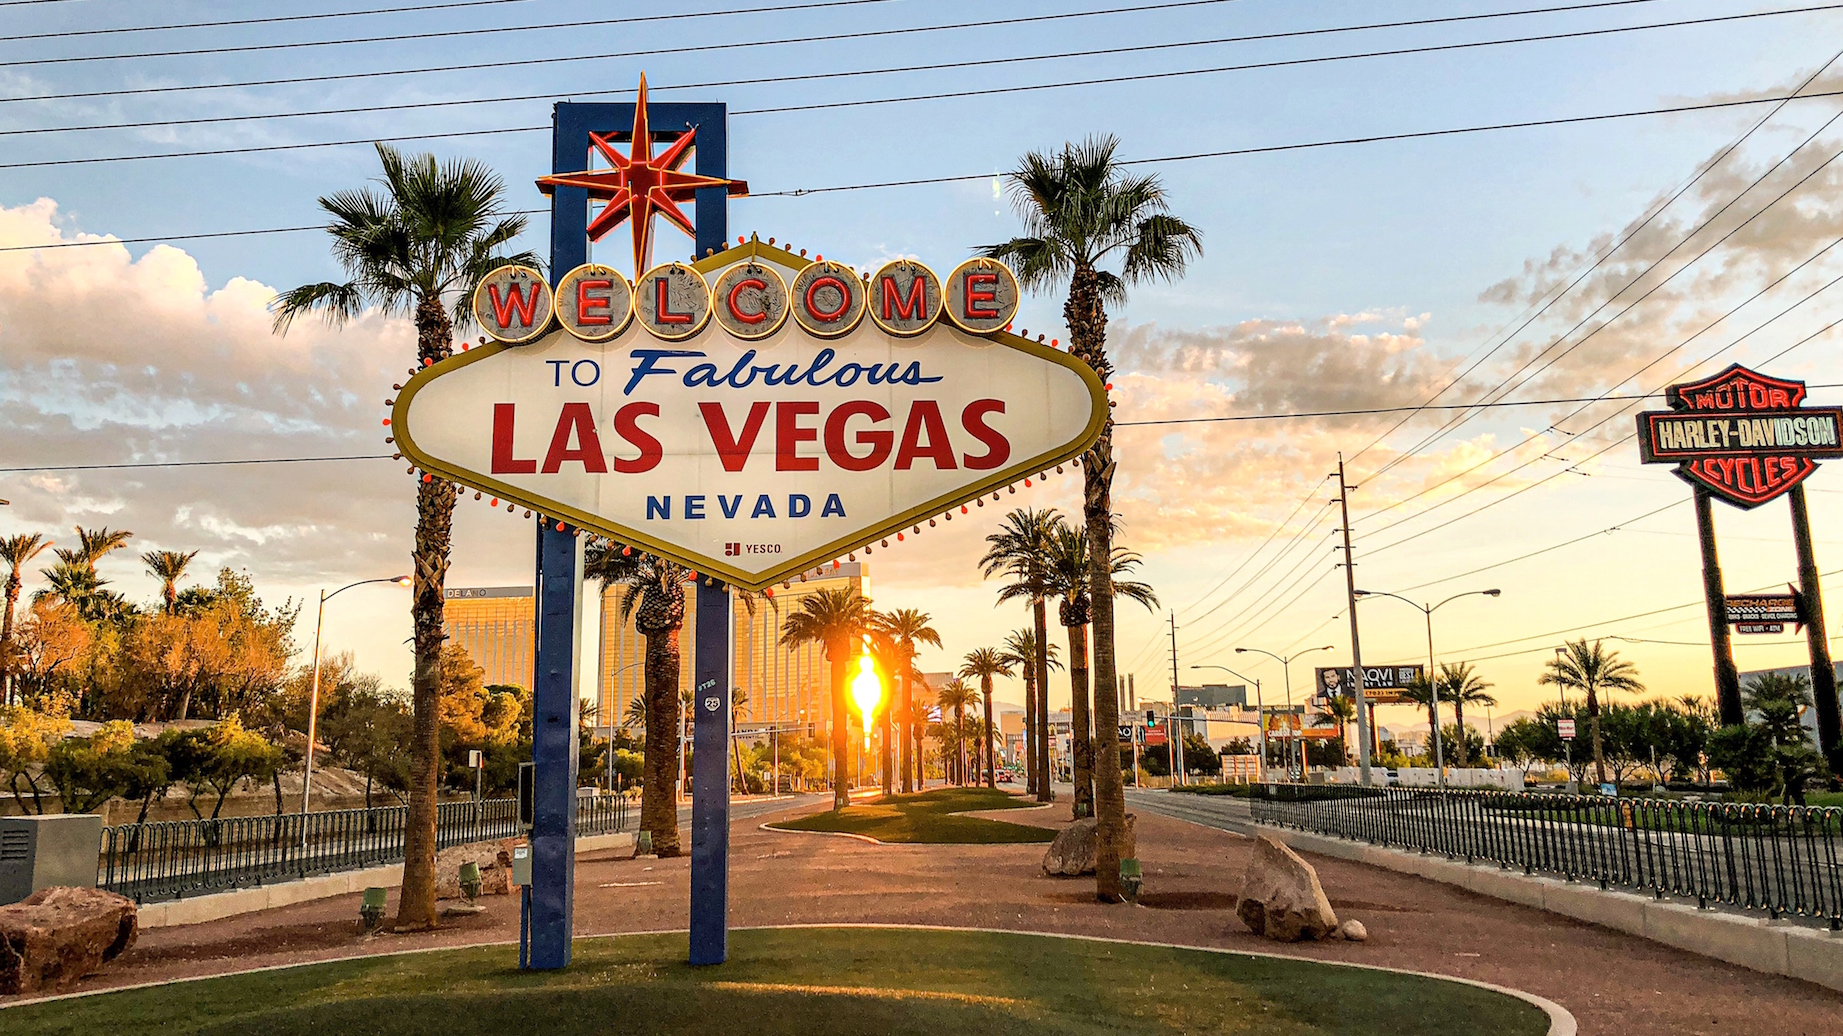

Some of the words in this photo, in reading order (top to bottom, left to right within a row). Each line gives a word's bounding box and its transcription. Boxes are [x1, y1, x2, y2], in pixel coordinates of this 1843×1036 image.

[488, 272, 999, 328] WELCOME
[545, 359, 600, 387] TO
[623, 348, 943, 395] Fabulous
[1695, 378, 1790, 409] MOTOR
[490, 402, 663, 474] LAS
[697, 399, 1011, 473] VEGAS
[1658, 416, 1837, 449] HARLEY-DAVIDSON
[1703, 456, 1798, 494] CYCLES
[646, 493, 847, 520] NEVADA
[746, 543, 782, 554] YESCO
[447, 589, 487, 598] DELANO
[706, 700, 719, 708] 25
